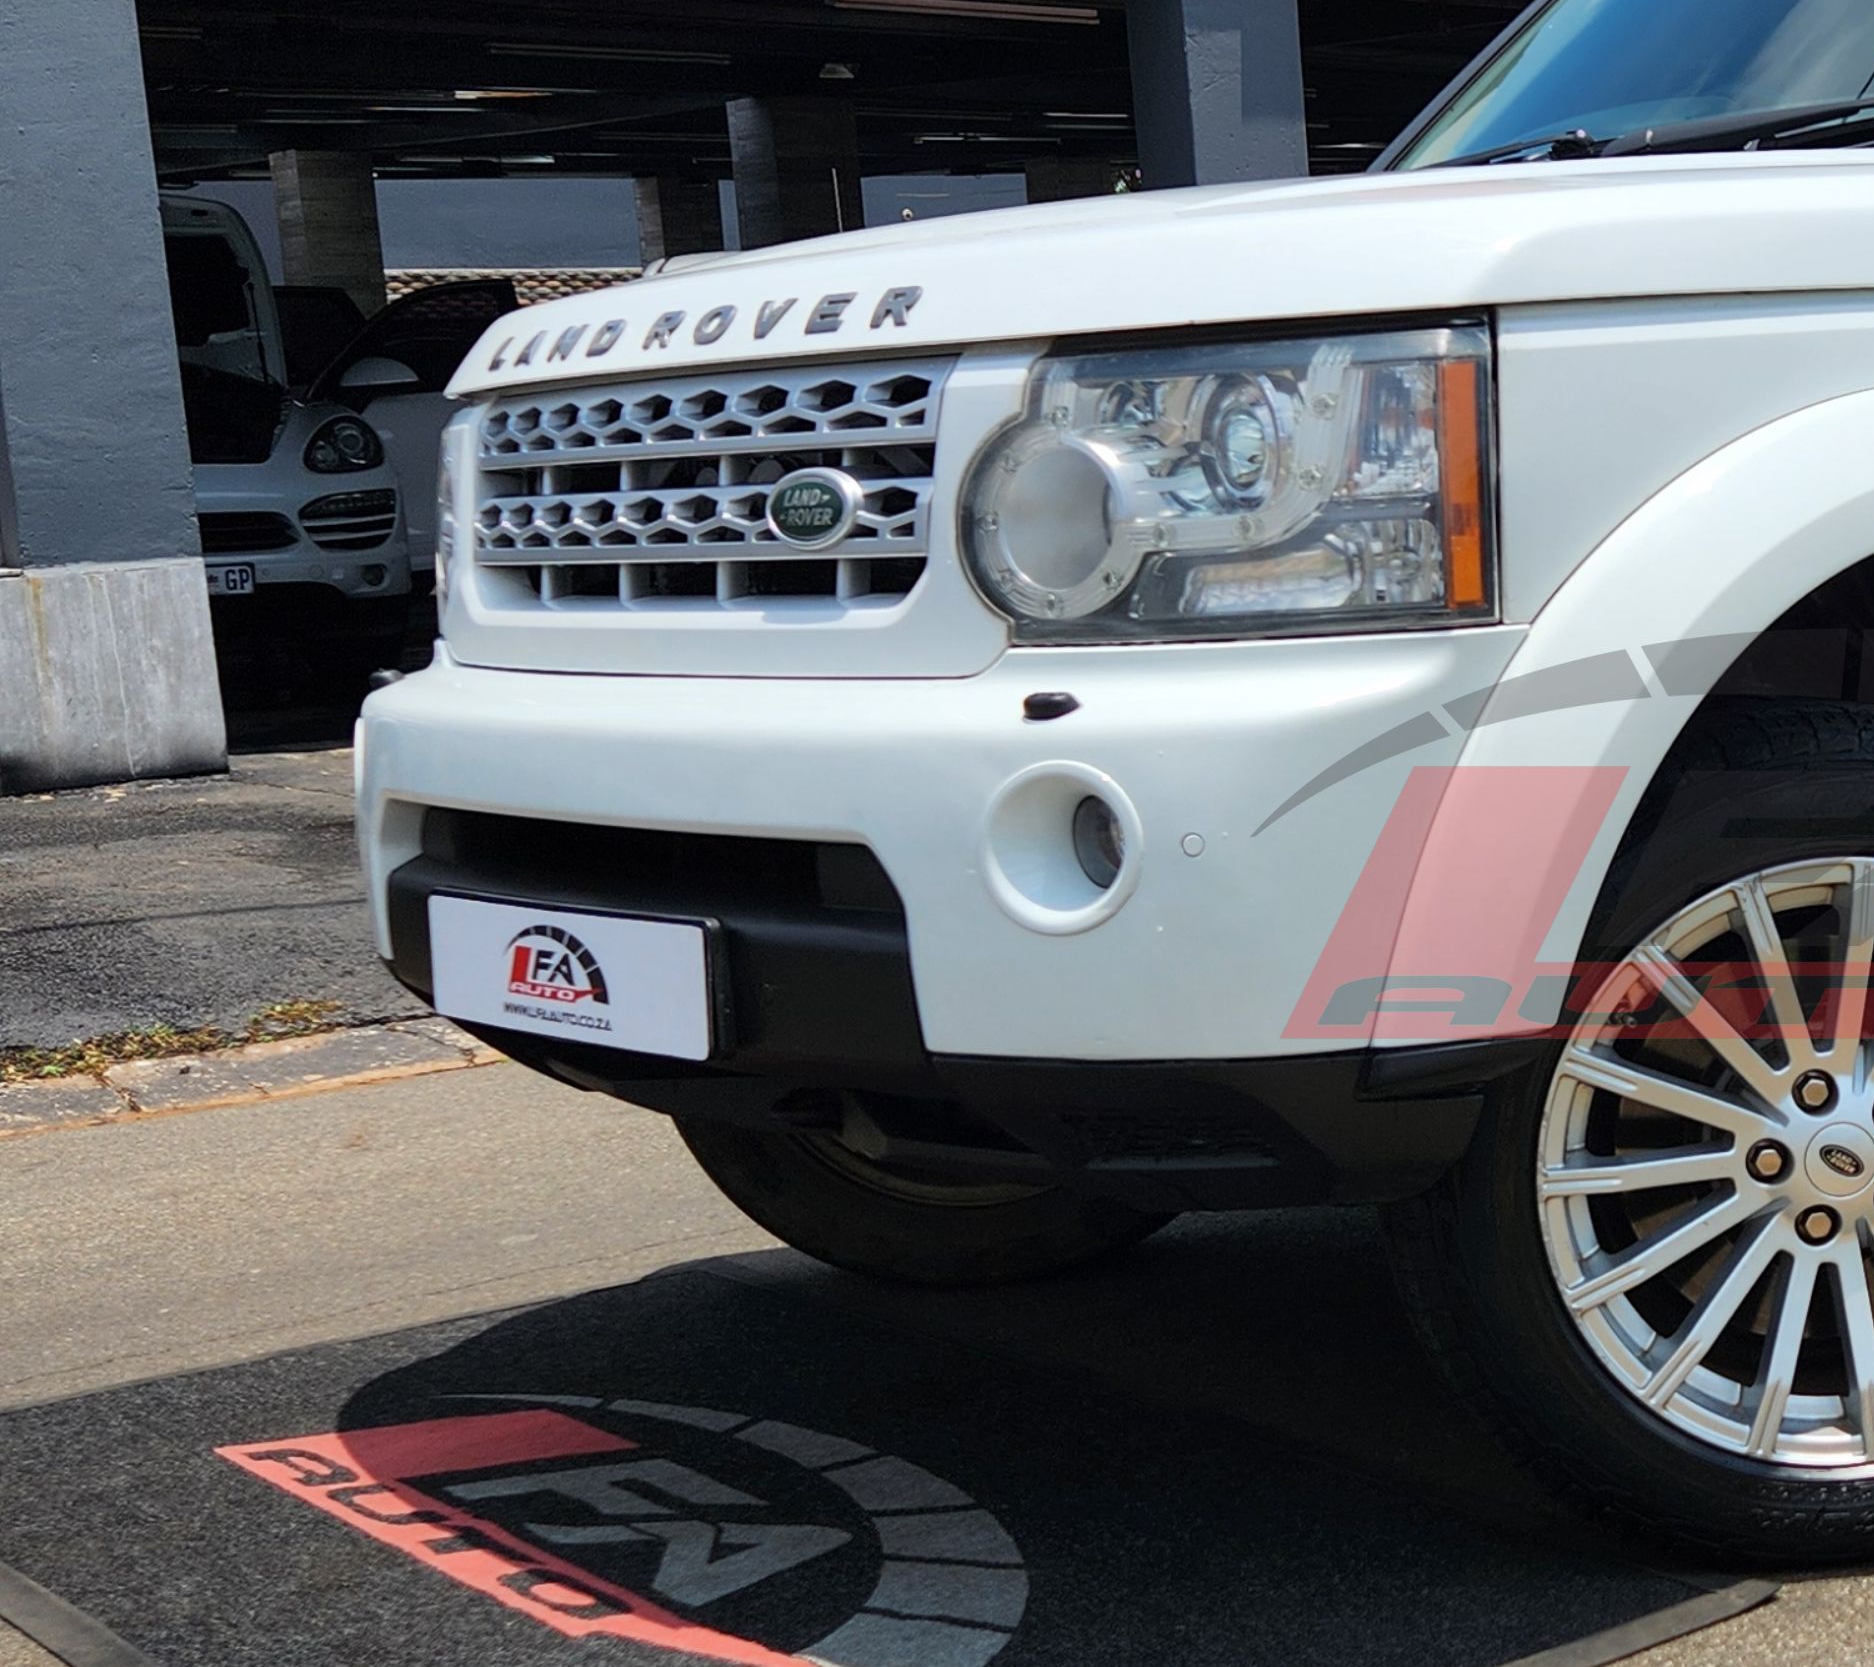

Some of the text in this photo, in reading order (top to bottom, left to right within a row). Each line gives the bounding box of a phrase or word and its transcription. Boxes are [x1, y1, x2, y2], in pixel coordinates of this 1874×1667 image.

[488, 285, 924, 371] LAND ROVER
[783, 489, 822, 506] LAND
[786, 508, 834, 526] ROVER
[225, 568, 250, 591] GP
[508, 945, 577, 992] LFA
[510, 982, 576, 1001] AUTO
[247, 1448, 635, 1620] AUTO
